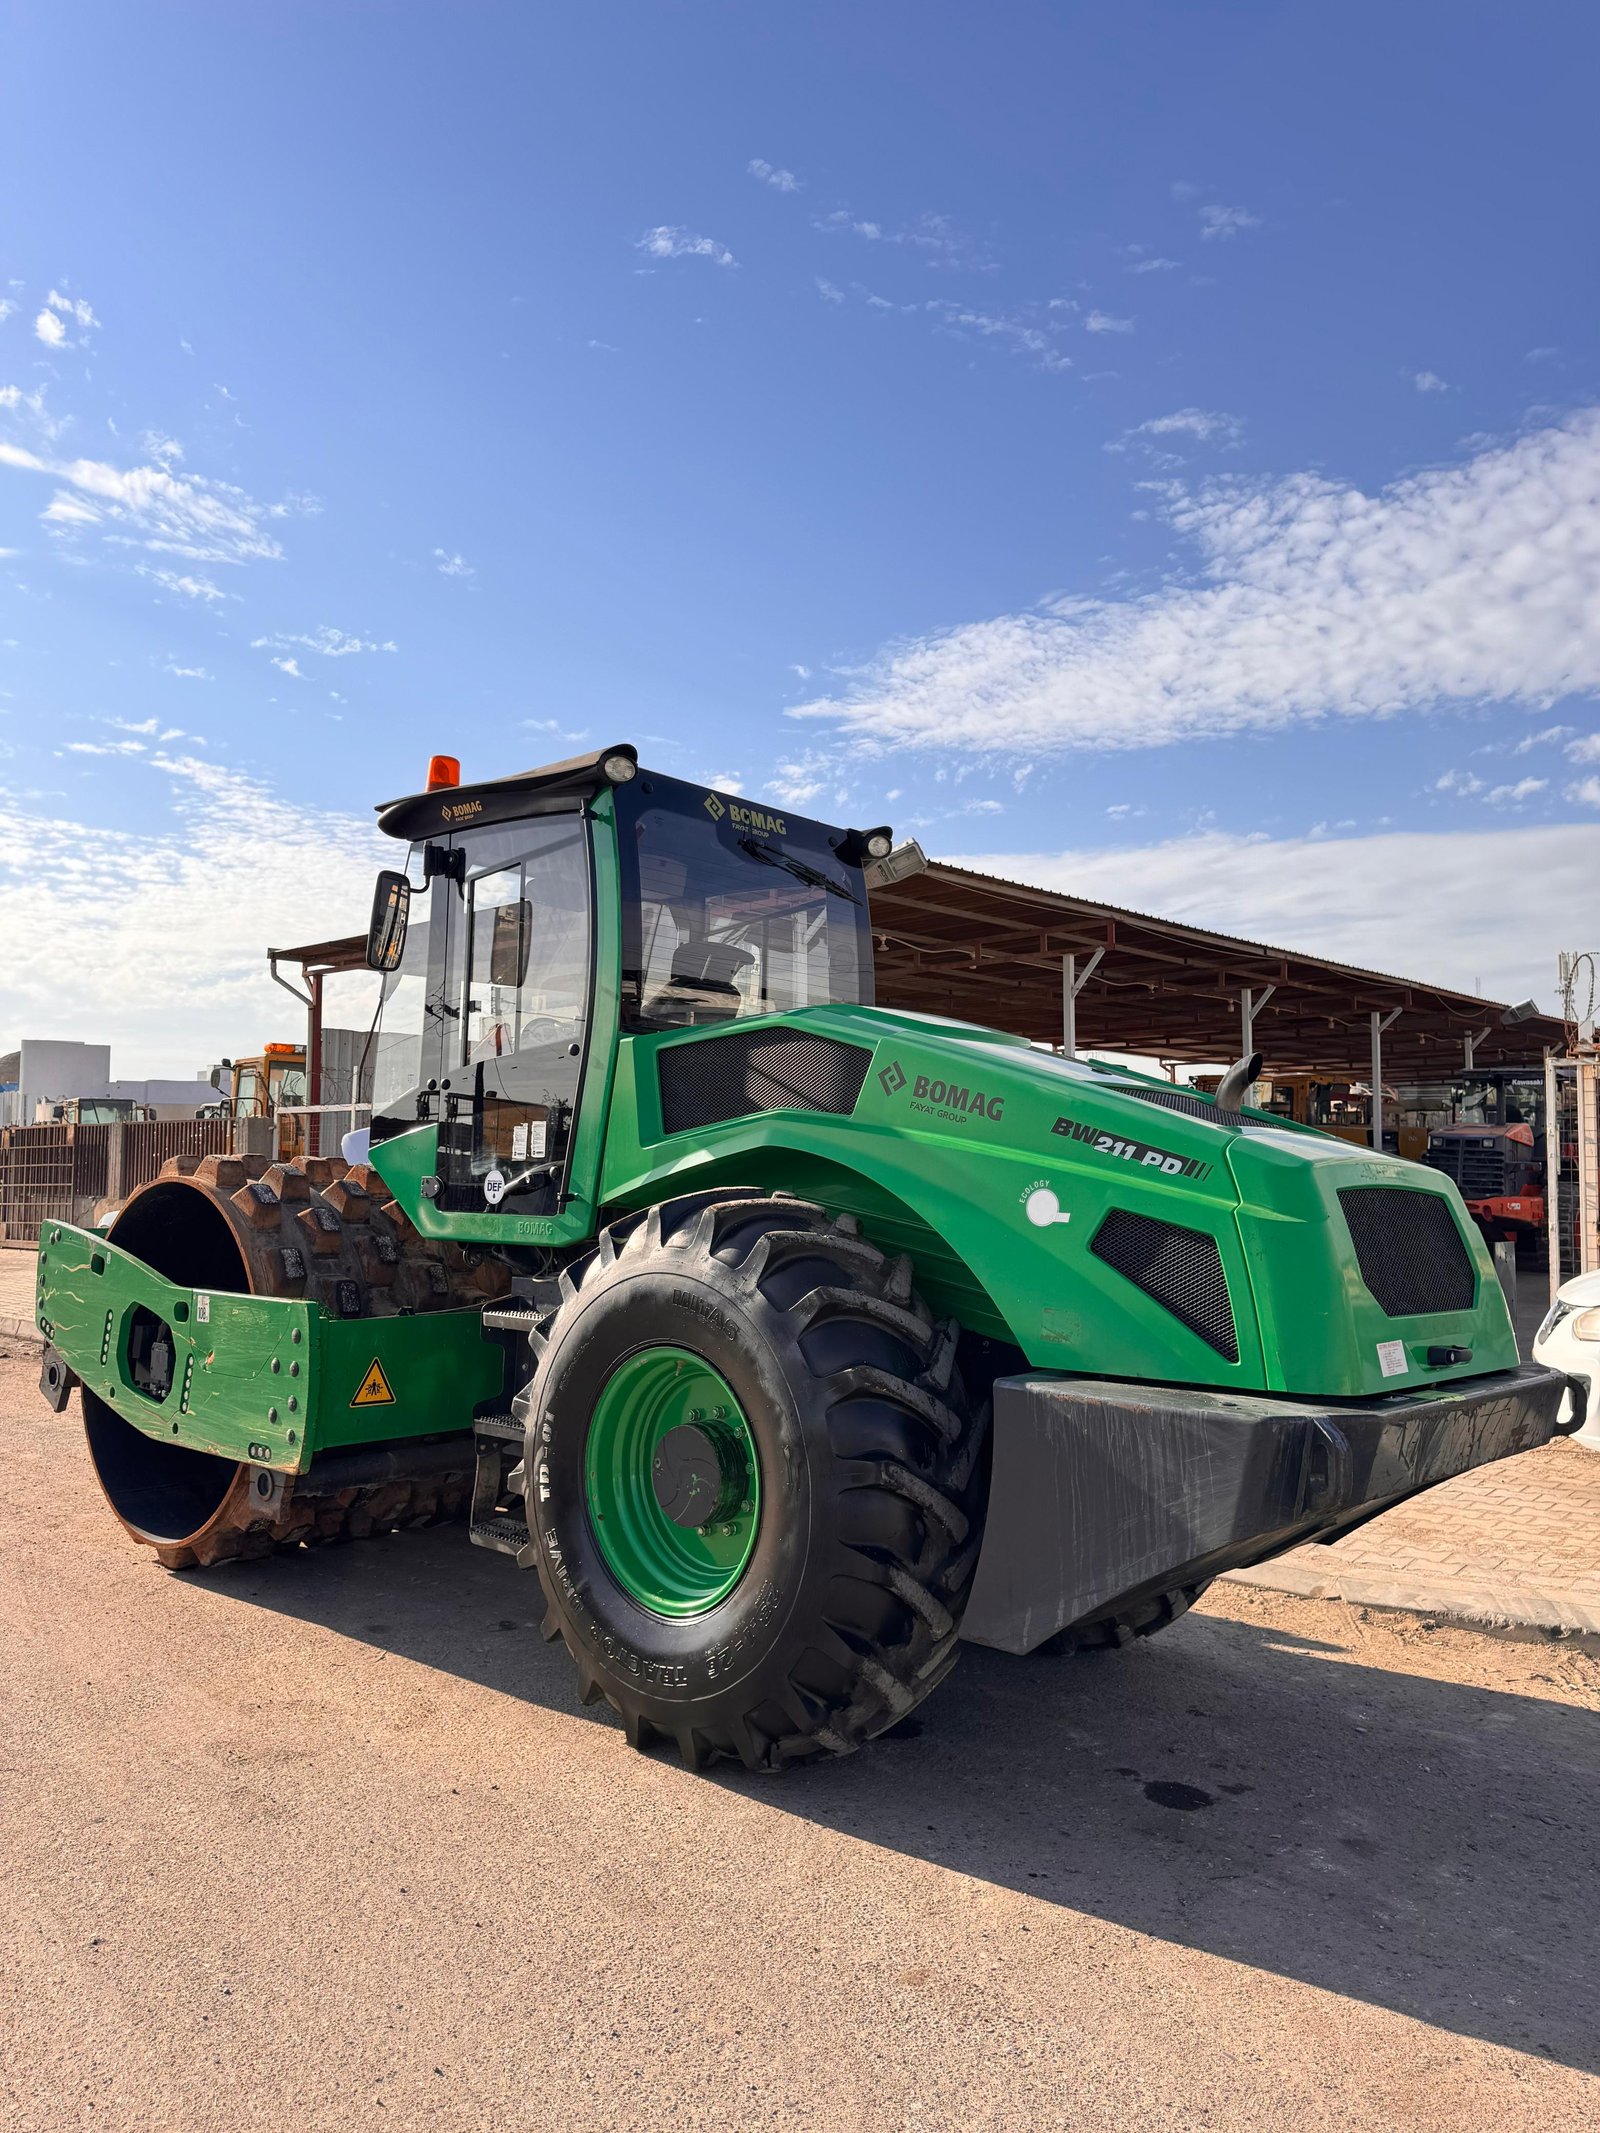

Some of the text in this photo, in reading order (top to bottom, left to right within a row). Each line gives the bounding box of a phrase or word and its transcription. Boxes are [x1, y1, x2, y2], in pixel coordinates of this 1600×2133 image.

[452, 800, 483, 817] BOMAG
[729, 804, 787, 835] BOMAG
[912, 1075, 1005, 1121] BOMAG
[909, 1101, 967, 1124] FAYAT GROUP
[1140, 1151, 1183, 1175] PD
[487, 1182, 503, 1192] DEF
[1019, 1179, 1050, 1204] ECOLOGY
[518, 1221, 553, 1236] BOMAG
[672, 1287, 740, 1341] MITAS
[545, 1528, 585, 1615] DRIVE
[590, 1620, 688, 1687] TRACTOR
